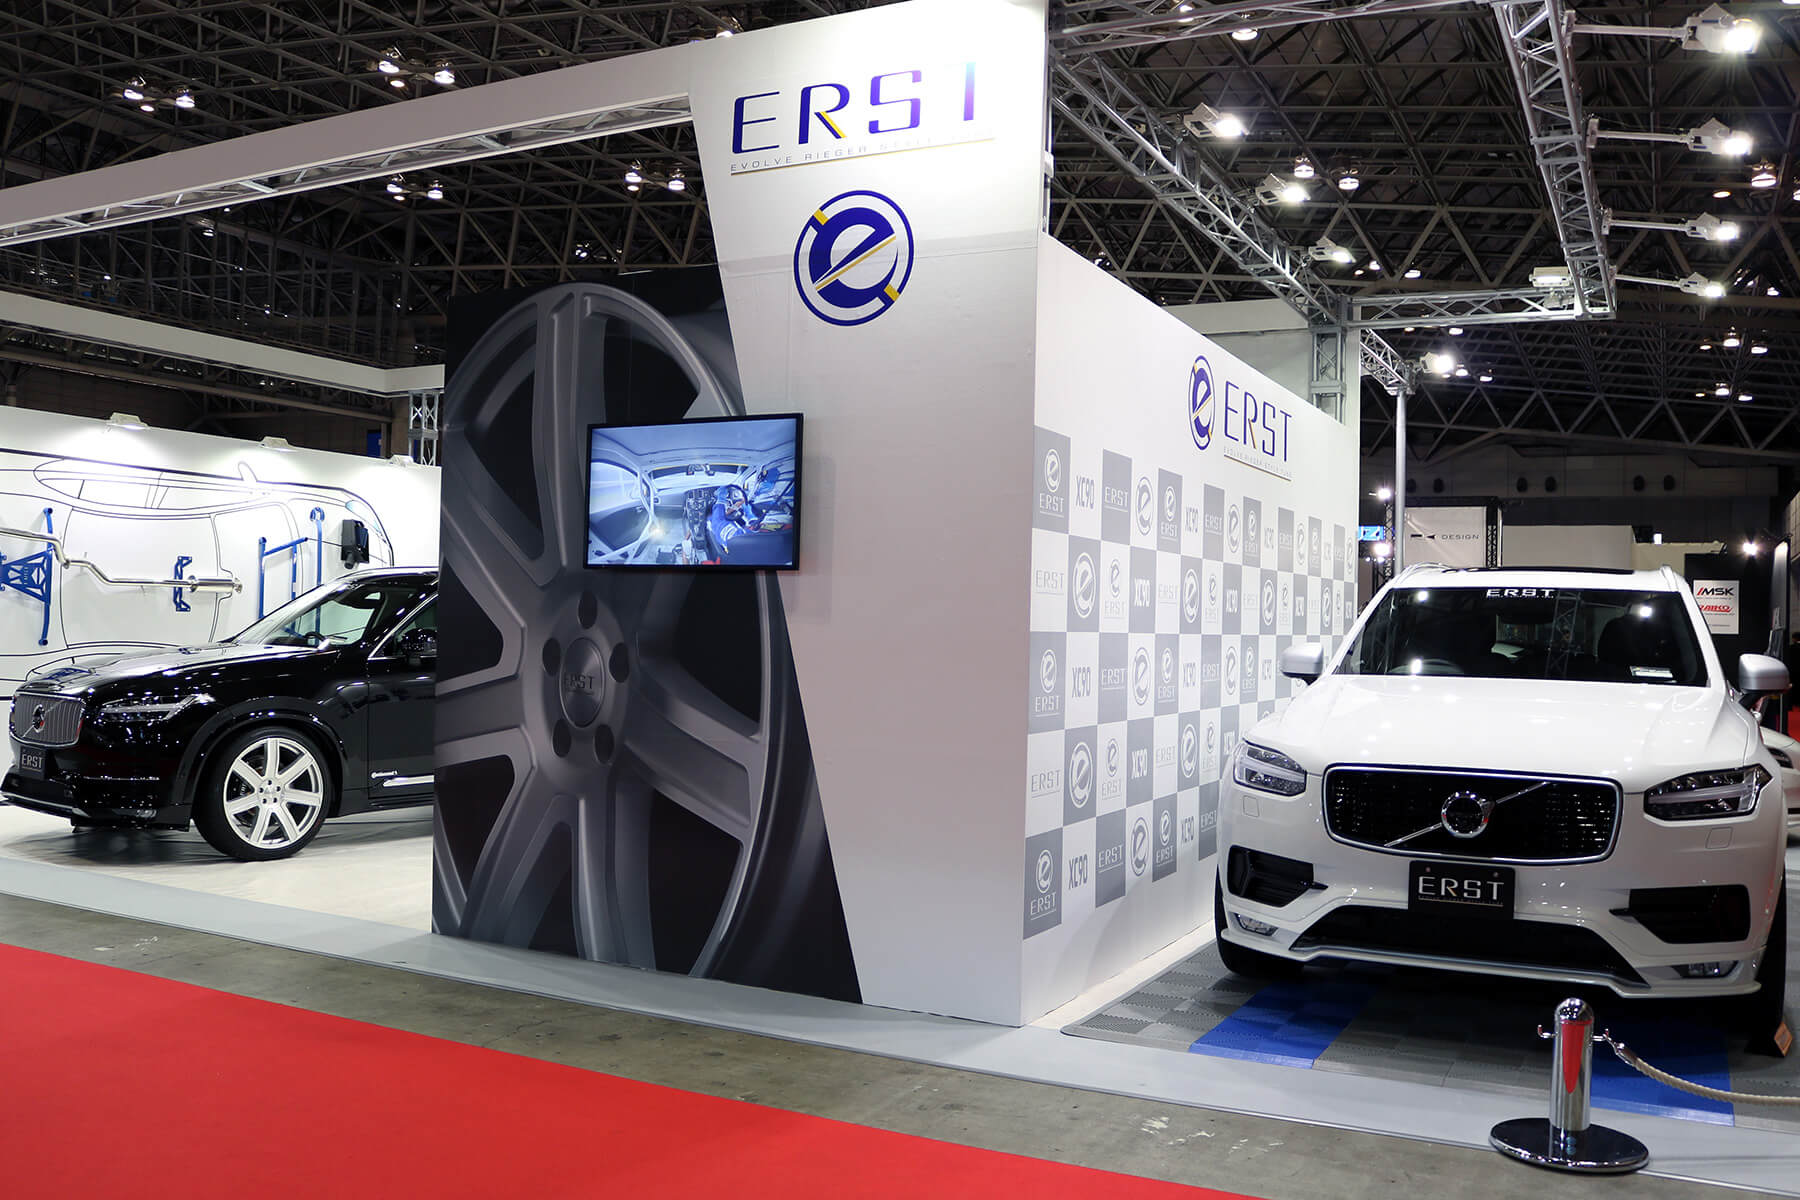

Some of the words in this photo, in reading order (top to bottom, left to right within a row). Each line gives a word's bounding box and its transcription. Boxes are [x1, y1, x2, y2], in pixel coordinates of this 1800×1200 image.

[730, 155, 793, 172] EVOLVE
[1224, 381, 1292, 462] ERST
[1039, 493, 1064, 513] ERST
[1075, 475, 1095, 510] XC90
[1104, 486, 1128, 507] ERST
[1035, 569, 1064, 590] ERST
[1486, 588, 1556, 598] ERST
[1072, 666, 1091, 698] XC90
[1101, 668, 1127, 685] ERST
[1035, 695, 1060, 713] ERST
[22, 753, 43, 769] ERST
[1031, 769, 1061, 793] ERST
[1098, 844, 1124, 868] ERST
[1156, 845, 1174, 863] ERST
[1068, 853, 1089, 890] XC90
[1418, 876, 1504, 900] ERST
[1030, 892, 1057, 916] ERST
